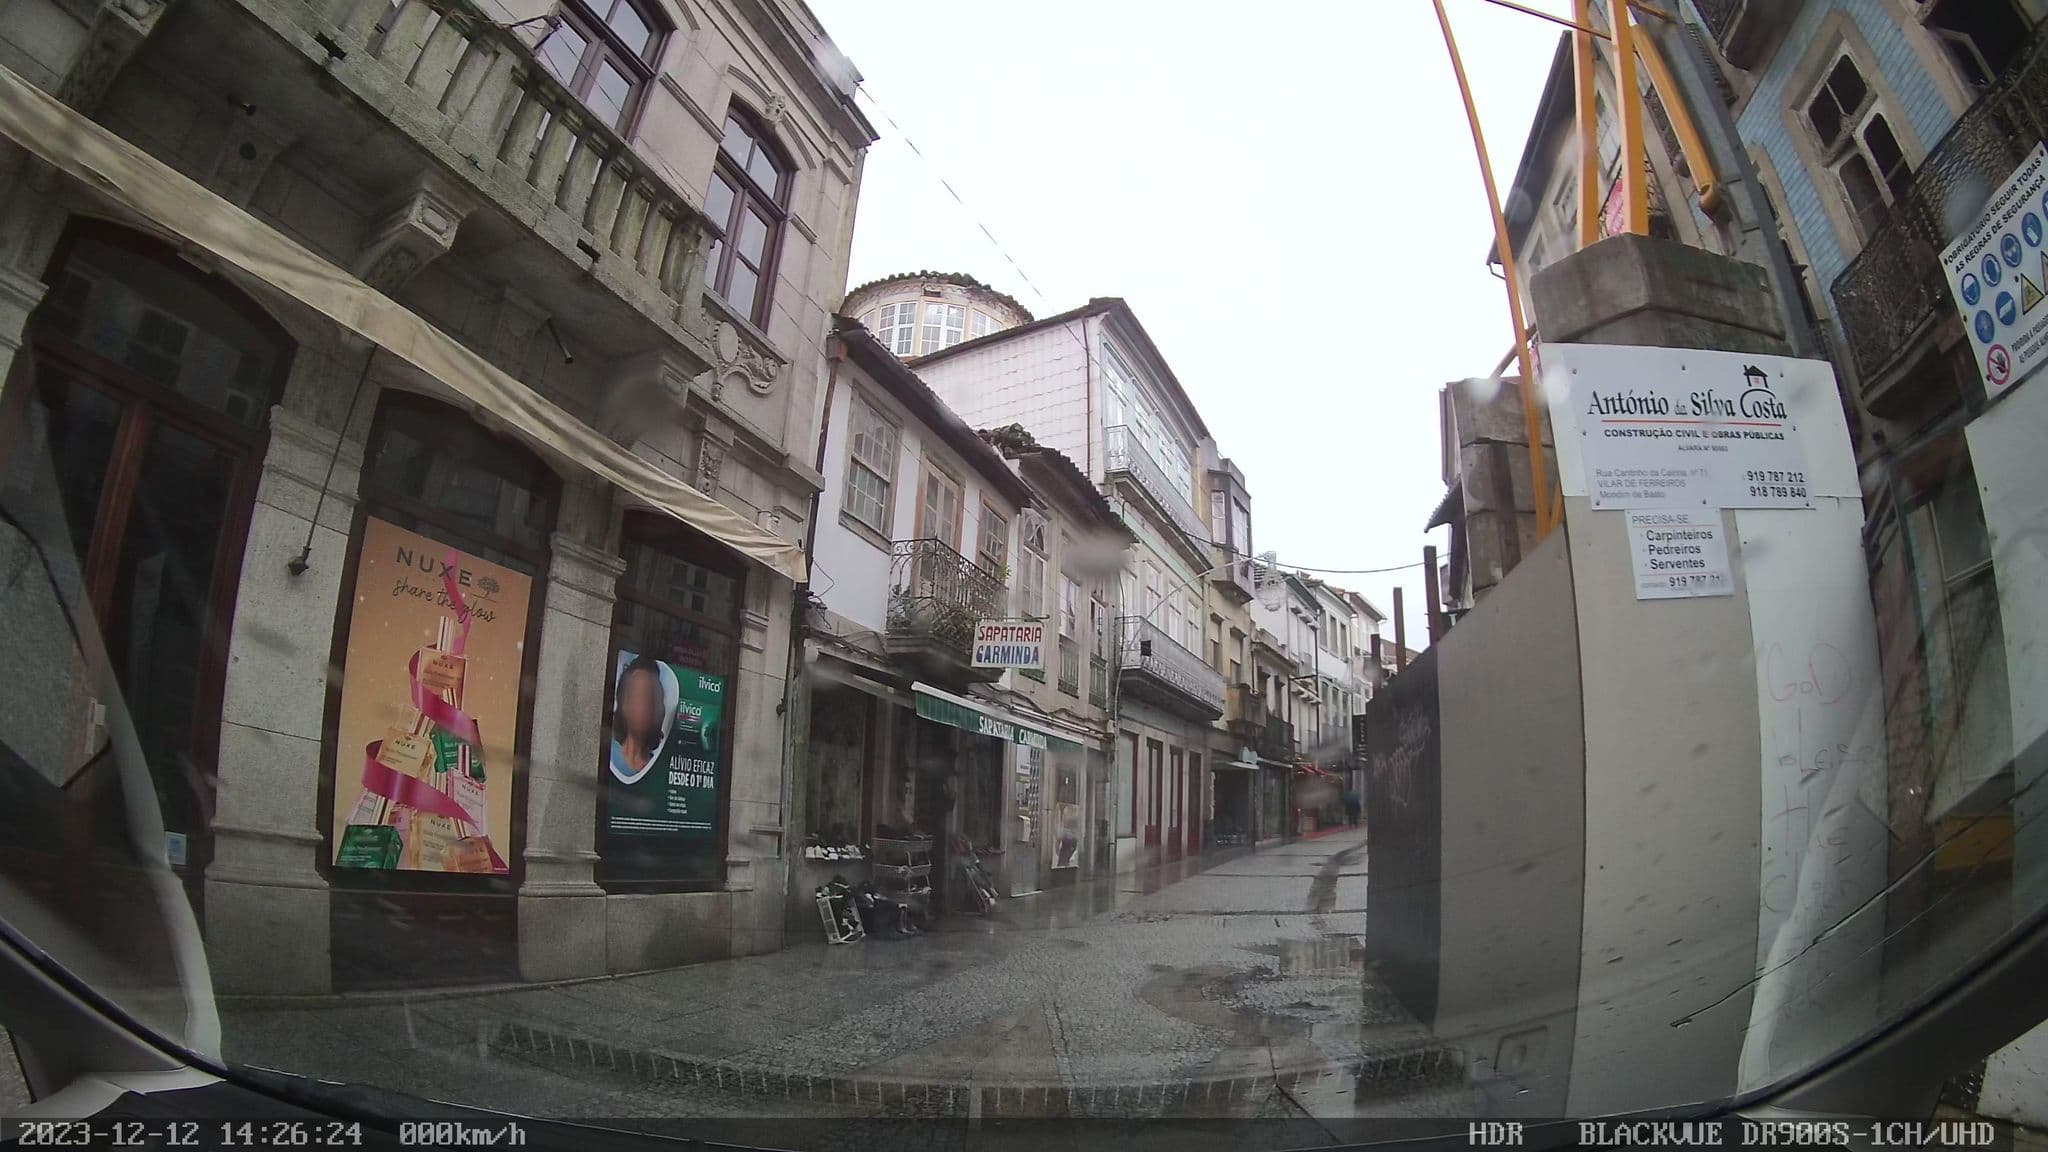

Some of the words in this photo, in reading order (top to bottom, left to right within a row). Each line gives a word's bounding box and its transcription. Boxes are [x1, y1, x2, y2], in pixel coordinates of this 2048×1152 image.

[1990, 183, 2019, 216] SEGUIR
[2016, 157, 2043, 187] TODAS
[1954, 260, 1966, 275] AS
[1964, 231, 1993, 264] REGRAS
[1991, 219, 2004, 235] DE
[2001, 173, 2047, 224] SEGURANÇA
[1587, 388, 1669, 415] António
[1690, 388, 1737, 417] Silva
[1740, 388, 1788, 419] Costa
[1604, 427, 1673, 439] CONSTRUÇÃO
[1675, 429, 1701, 438] CIVIL
[1711, 430, 1741, 439] OBRAS
[1747, 470, 1765, 481] 919
[1767, 471, 1784, 482] 787
[1787, 472, 1805, 483] 212
[1632, 514, 1689, 524] PRECISA-SE
[1646, 530, 1713, 543] Carpinteiros
[1648, 544, 1702, 555] Pedreiros
[396, 547, 473, 588] NUXE
[1650, 559, 1706, 570] Serventes
[1669, 576, 1688, 587] 919
[393, 576, 433, 601] share
[458, 600, 496, 624] glow
[978, 626, 1042, 642] SAPATARIA
[699, 676, 721, 693] ilvico
[680, 701, 702, 716] ilvico
[395, 739, 416, 750] NUXE
[693, 759, 715, 775] EFICAZ
[668, 771, 689, 787] DESDE
[703, 775, 714, 789] DIA
[430, 819, 451, 831] NUXE
